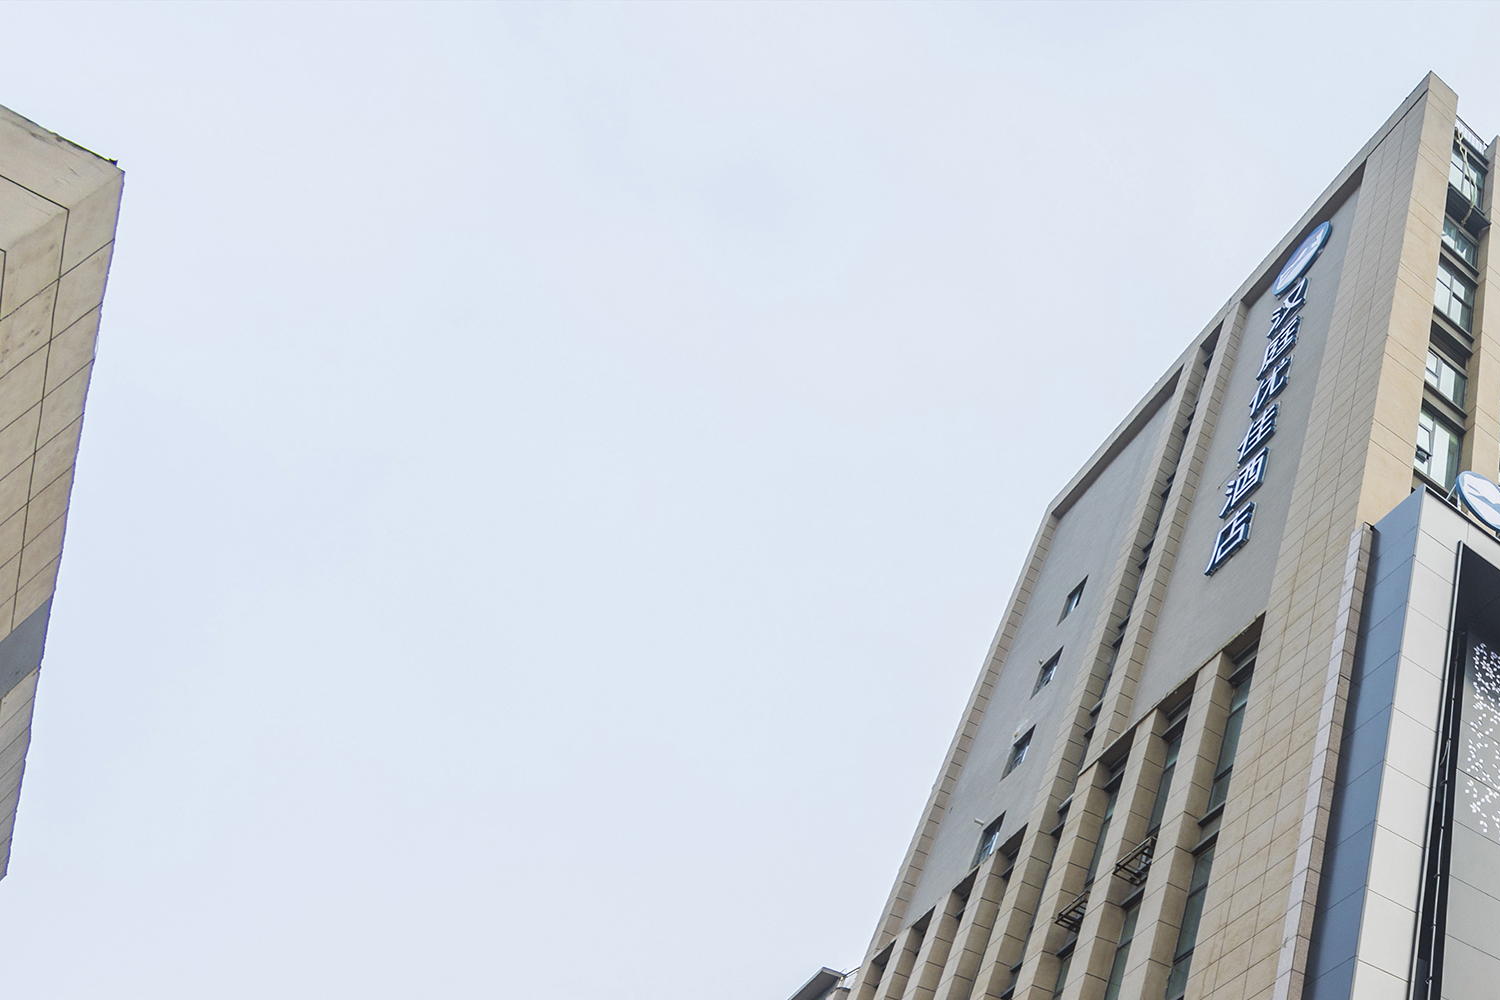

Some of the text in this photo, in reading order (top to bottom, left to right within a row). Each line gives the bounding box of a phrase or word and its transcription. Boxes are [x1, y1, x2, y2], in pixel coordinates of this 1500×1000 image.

[1205, 277, 1310, 576] 汉庭优佳酒店
